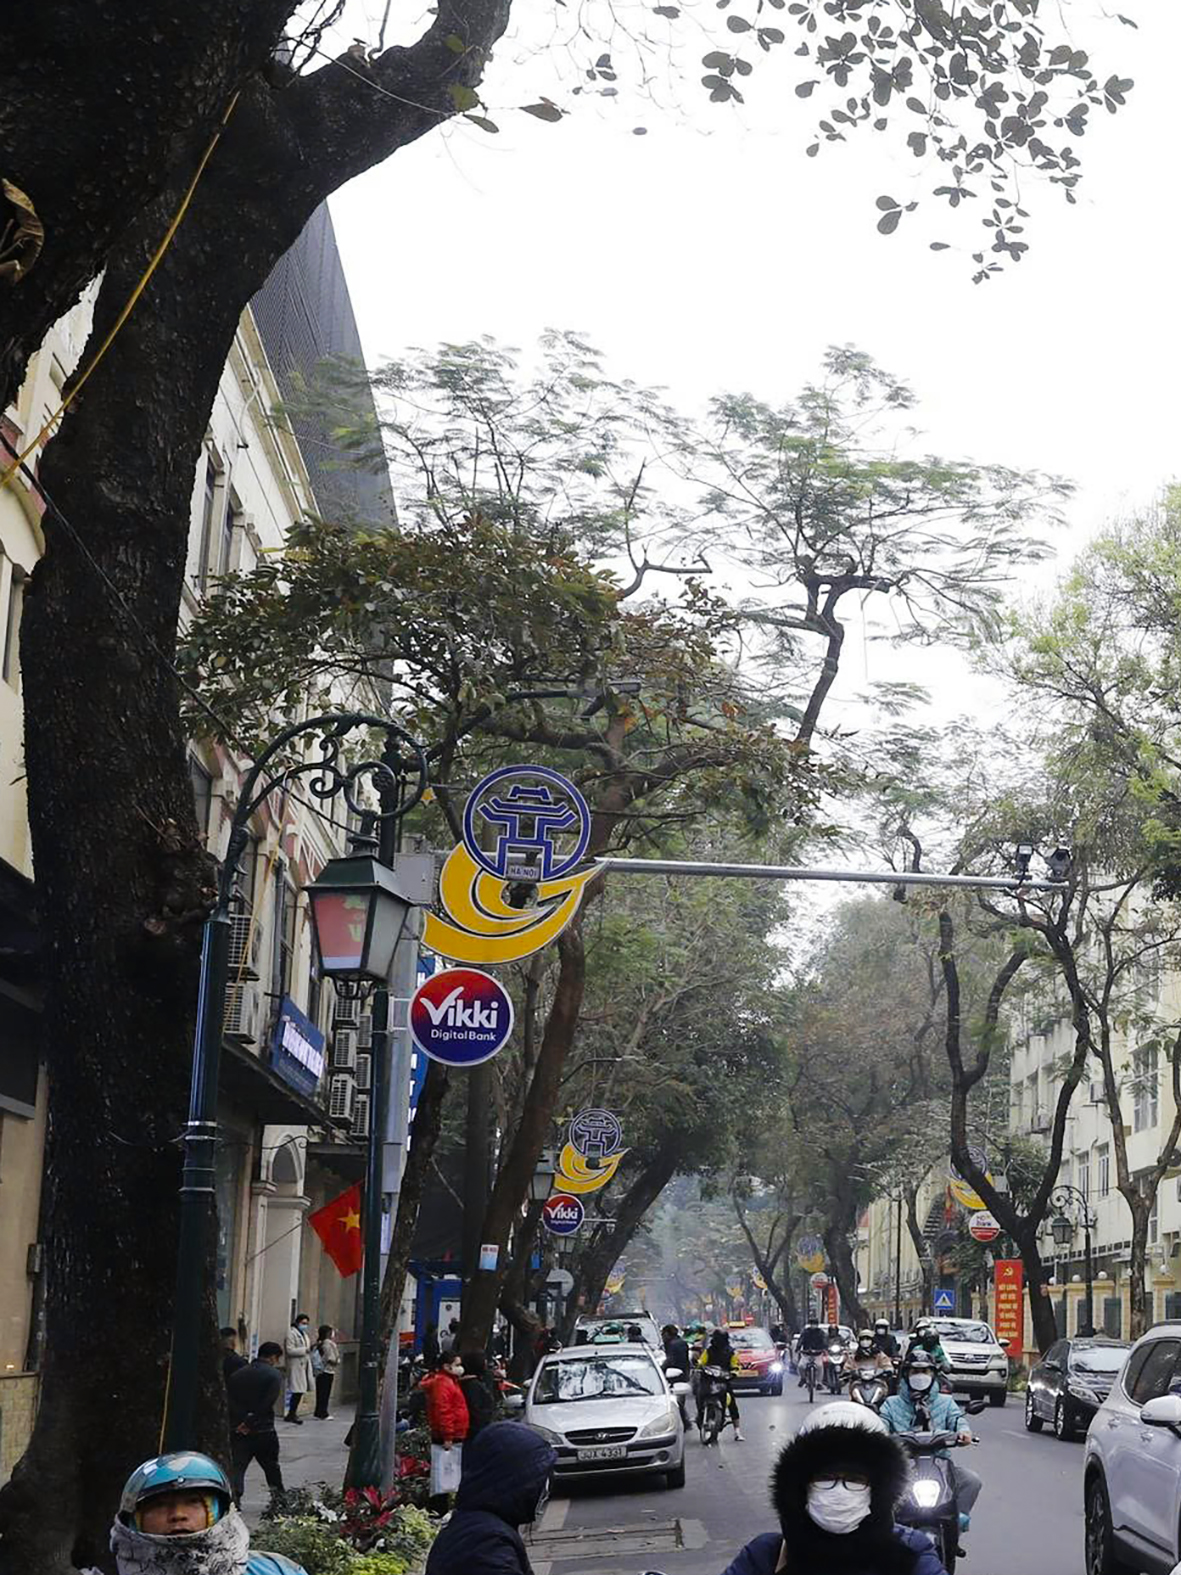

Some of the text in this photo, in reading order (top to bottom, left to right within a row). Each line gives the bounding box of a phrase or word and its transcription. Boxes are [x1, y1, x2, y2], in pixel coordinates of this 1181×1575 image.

[420, 986, 498, 1028] Vikki
[431, 1029, 496, 1041] Digital Bank
[545, 1202, 578, 1219] Vikki
